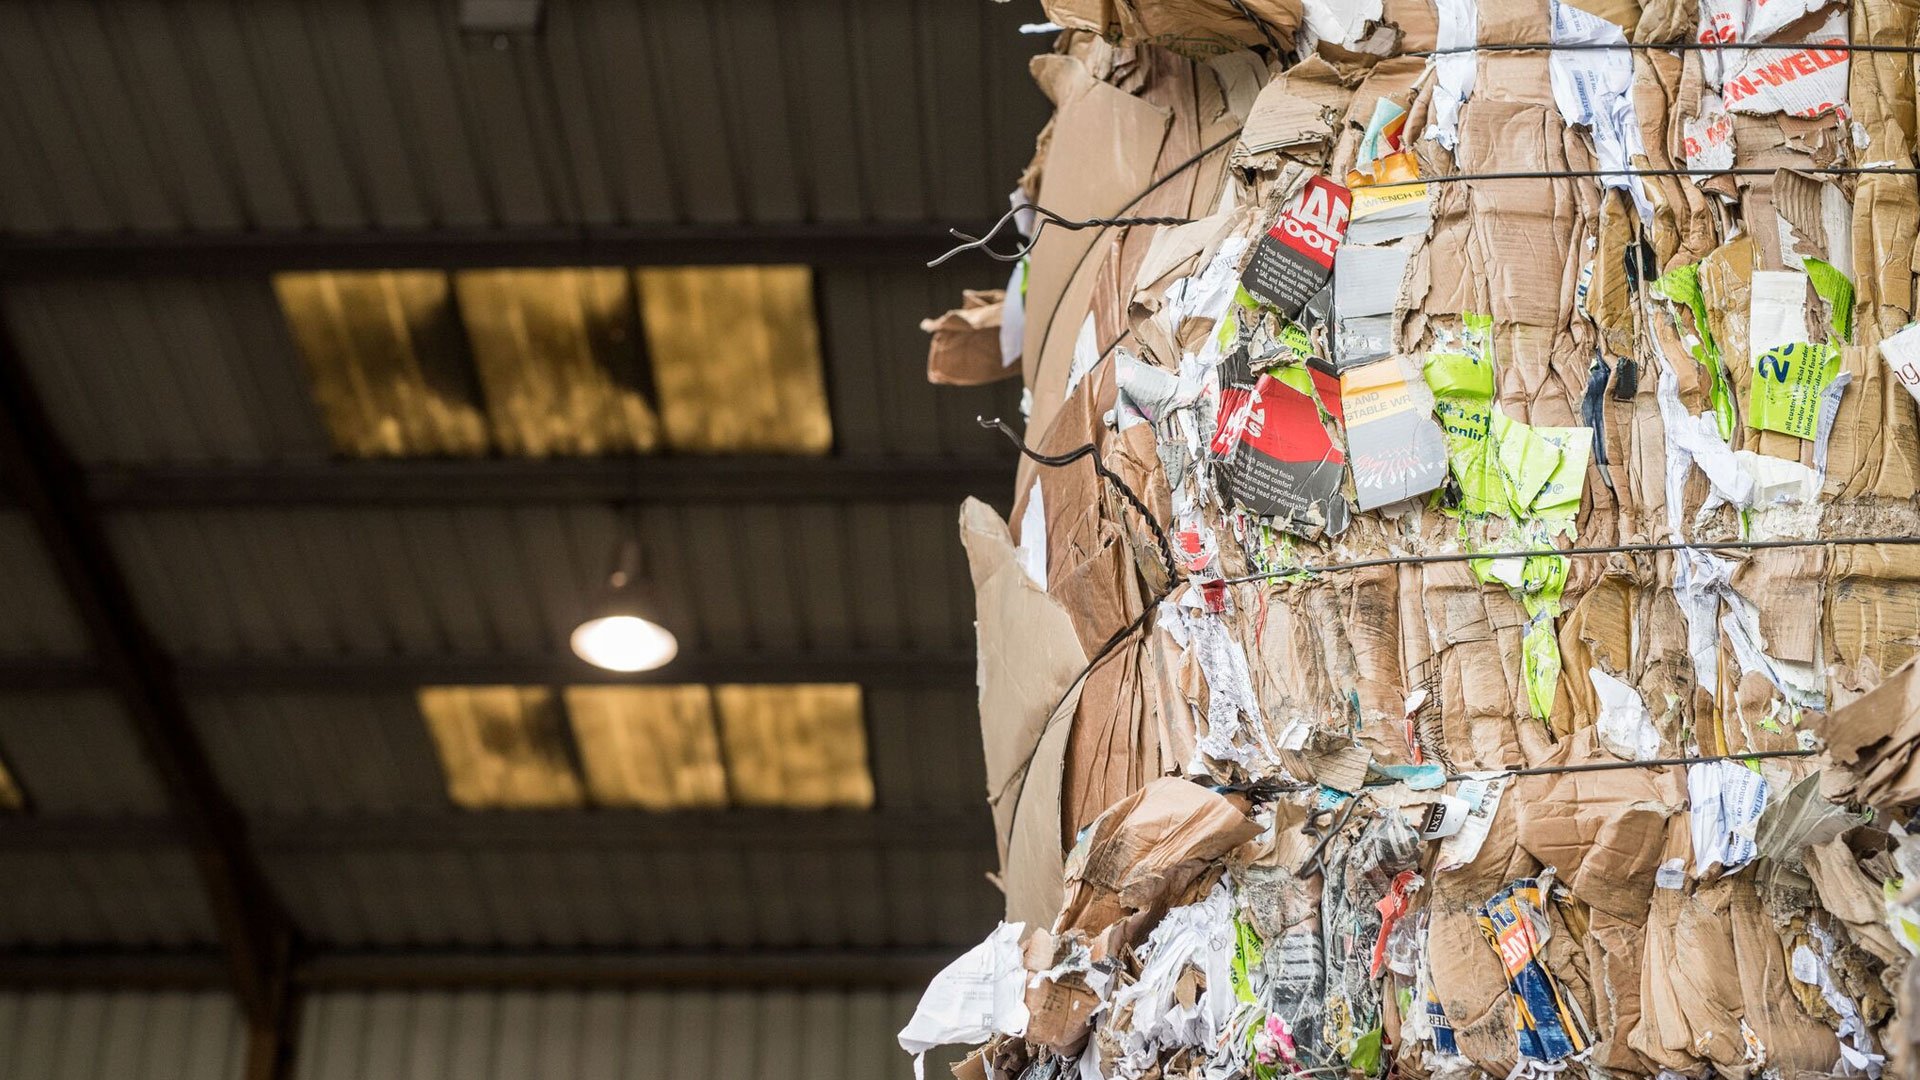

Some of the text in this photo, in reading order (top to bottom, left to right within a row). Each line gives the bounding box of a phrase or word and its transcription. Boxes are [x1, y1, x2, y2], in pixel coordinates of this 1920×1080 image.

[1363, 192, 1412, 208] WRENCH
[1262, 253, 1288, 271] Cushioned
[1286, 268, 1298, 278] grip
[1296, 273, 1315, 287] handles
[1264, 245, 1277, 257] Drop
[1275, 252, 1292, 266] forged
[1290, 260, 1304, 272] steel
[1302, 267, 1315, 278] with
[1258, 270, 1269, 280] SAE
[1268, 275, 1279, 285] and
[1277, 281, 1293, 293] Metric
[1260, 262, 1268, 270] All
[1267, 266, 1281, 278] pliers
[1280, 273, 1298, 286] exceed
[1256, 277, 1274, 291] wrench
[1272, 286, 1281, 295] for
[1279, 291, 1294, 303] quick
[1808, 354, 1818, 369] faux
[1805, 369, 1814, 384] and
[1354, 391, 1380, 406] AND
[1808, 399, 1817, 413] and
[1784, 421, 1792, 431] all
[1794, 407, 1806, 433] Levolor
[1803, 414, 1815, 436] blinds
[1243, 453, 1256, 466] high
[1255, 460, 1279, 475] polished
[1278, 470, 1295, 482] finish
[1245, 464, 1254, 473] for
[1253, 469, 1271, 480] added
[1270, 476, 1293, 490] comfort
[1231, 485, 1257, 501] reference
[1237, 470, 1309, 506] performance specifications
[1248, 484, 1257, 492] on
[1256, 488, 1271, 499] head
[1270, 493, 1278, 502] of
[1738, 781, 1746, 805] HOUSE
[1430, 804, 1446, 831] NEXT
[1737, 808, 1743, 817] OF
